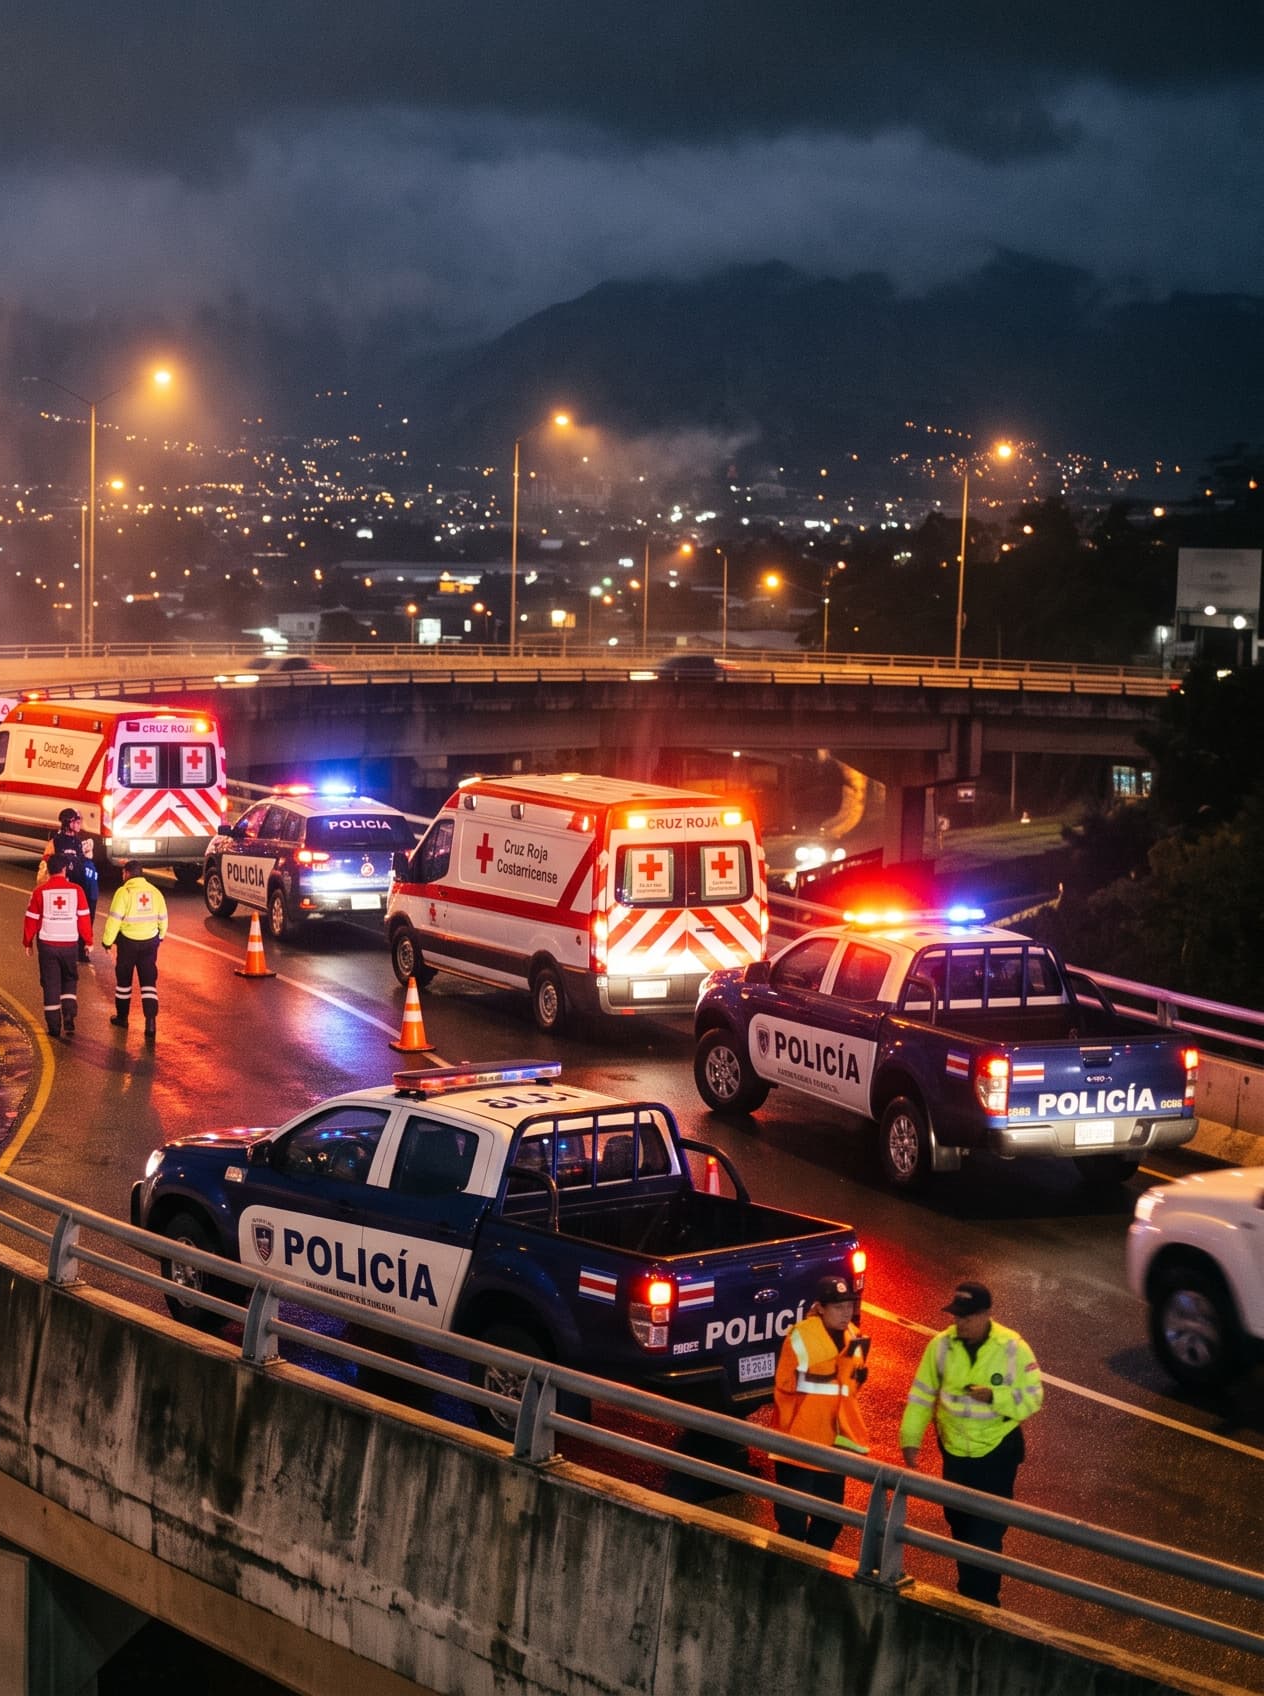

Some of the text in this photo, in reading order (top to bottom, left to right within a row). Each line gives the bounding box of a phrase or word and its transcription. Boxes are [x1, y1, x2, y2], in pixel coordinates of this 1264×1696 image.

[142, 724, 168, 733] CRUZ
[647, 816, 719, 830] CRUZ ROJA
[504, 839, 548, 864] Cruz Roja
[497, 859, 558, 884] Costarricense
[774, 1030, 861, 1084] POLICÍA
[1038, 1083, 1157, 1117] POLICÍA
[283, 1227, 438, 1308] POLICÍA
[705, 1299, 805, 1350] POLICÍ
